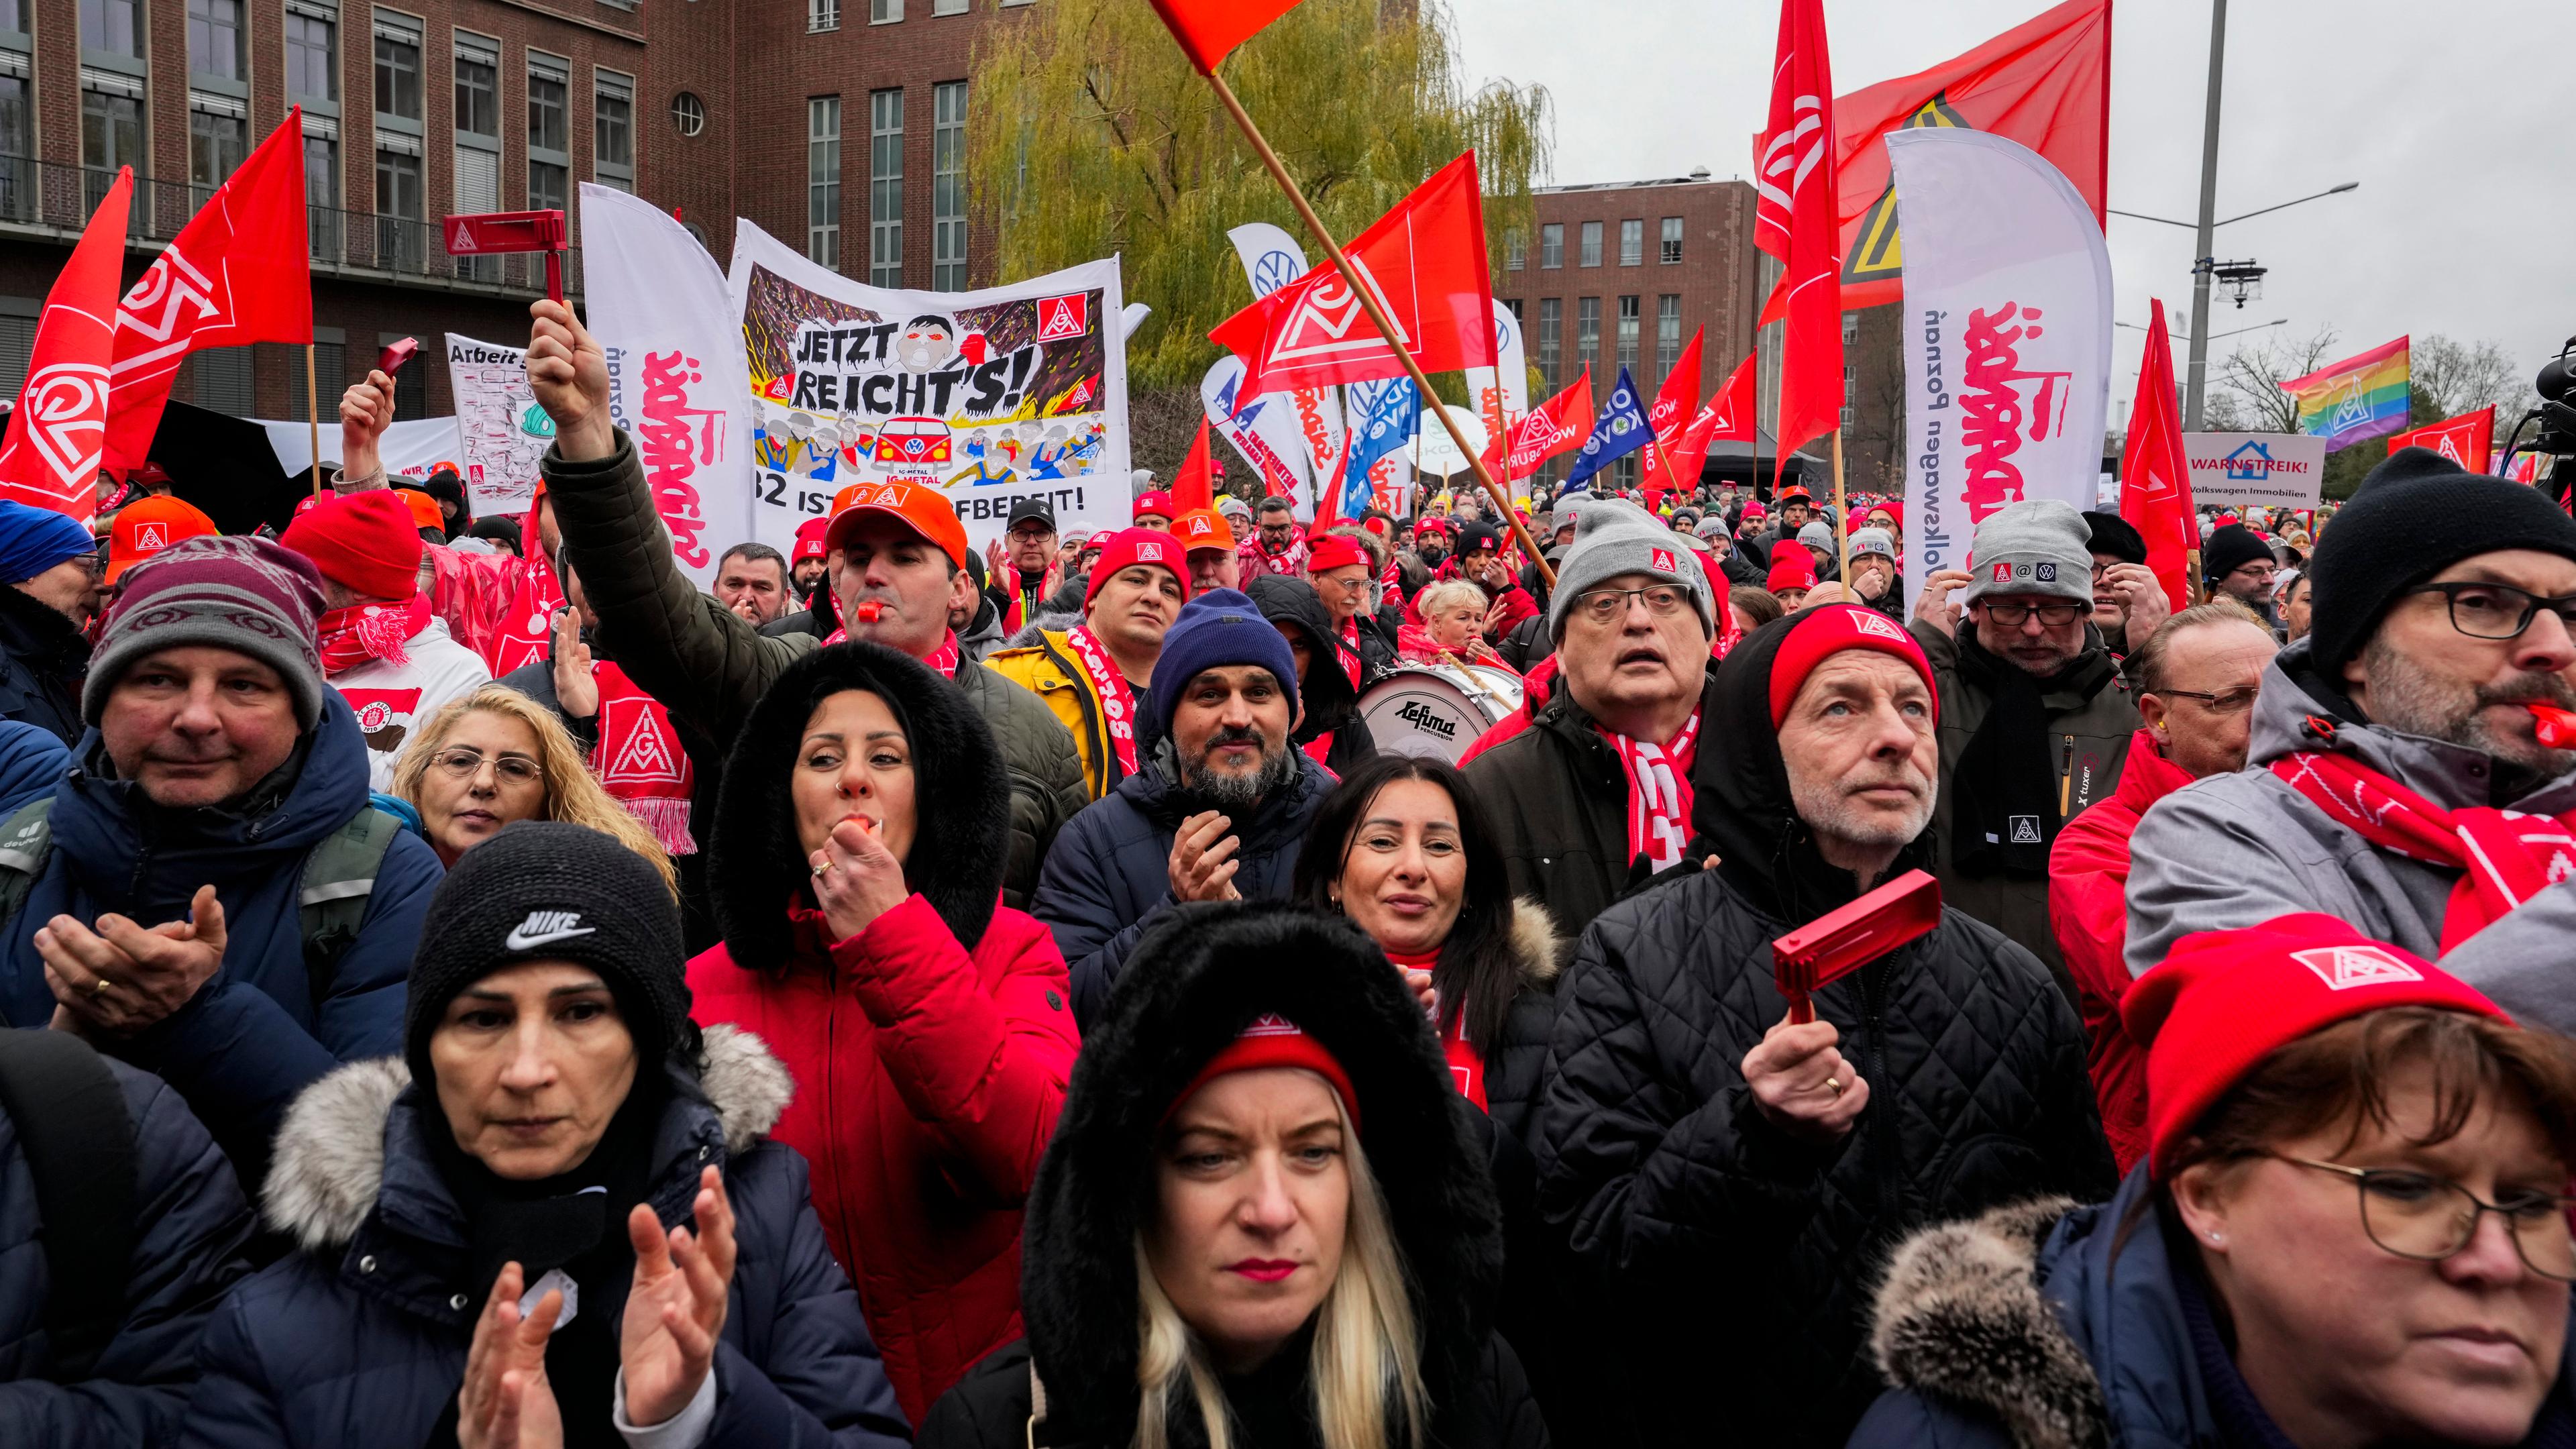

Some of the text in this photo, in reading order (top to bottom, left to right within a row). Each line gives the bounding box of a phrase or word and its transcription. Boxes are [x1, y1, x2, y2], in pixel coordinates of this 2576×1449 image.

[451, 345, 517, 364] Arbeit
[798, 323, 899, 371] JETZT
[792, 346, 1035, 417] REICHT'S!
[402, 466, 425, 476] WIR,
[2191, 459, 2308, 474] WARNSTREIK!
[2190, 486, 2306, 498] Volkswagen Immobilien
[376, 702, 390, 716] PAULI
[1420, 727, 1453, 742] PERCUSSION
[521, 911, 581, 934] NIKE
